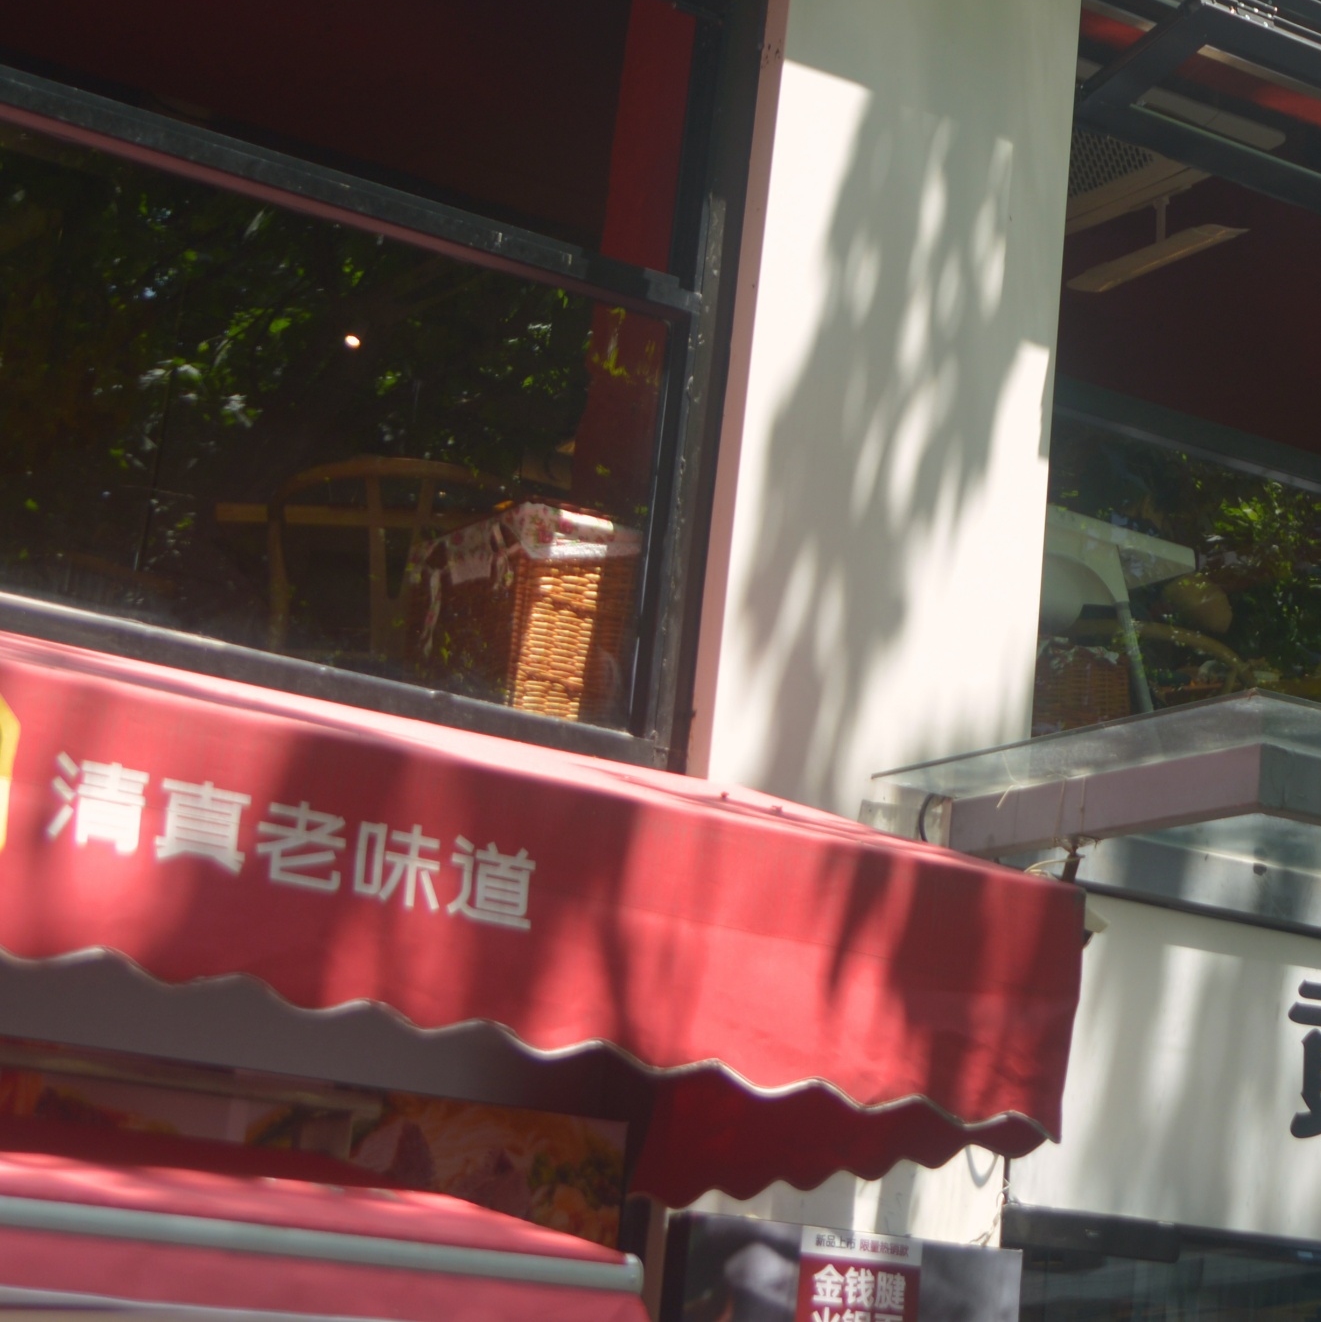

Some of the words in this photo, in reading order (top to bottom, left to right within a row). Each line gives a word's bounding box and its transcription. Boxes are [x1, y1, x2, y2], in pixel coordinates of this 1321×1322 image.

[46, 751, 537, 930] 清真老味道
[813, 1263, 907, 1310] 金钱腱
